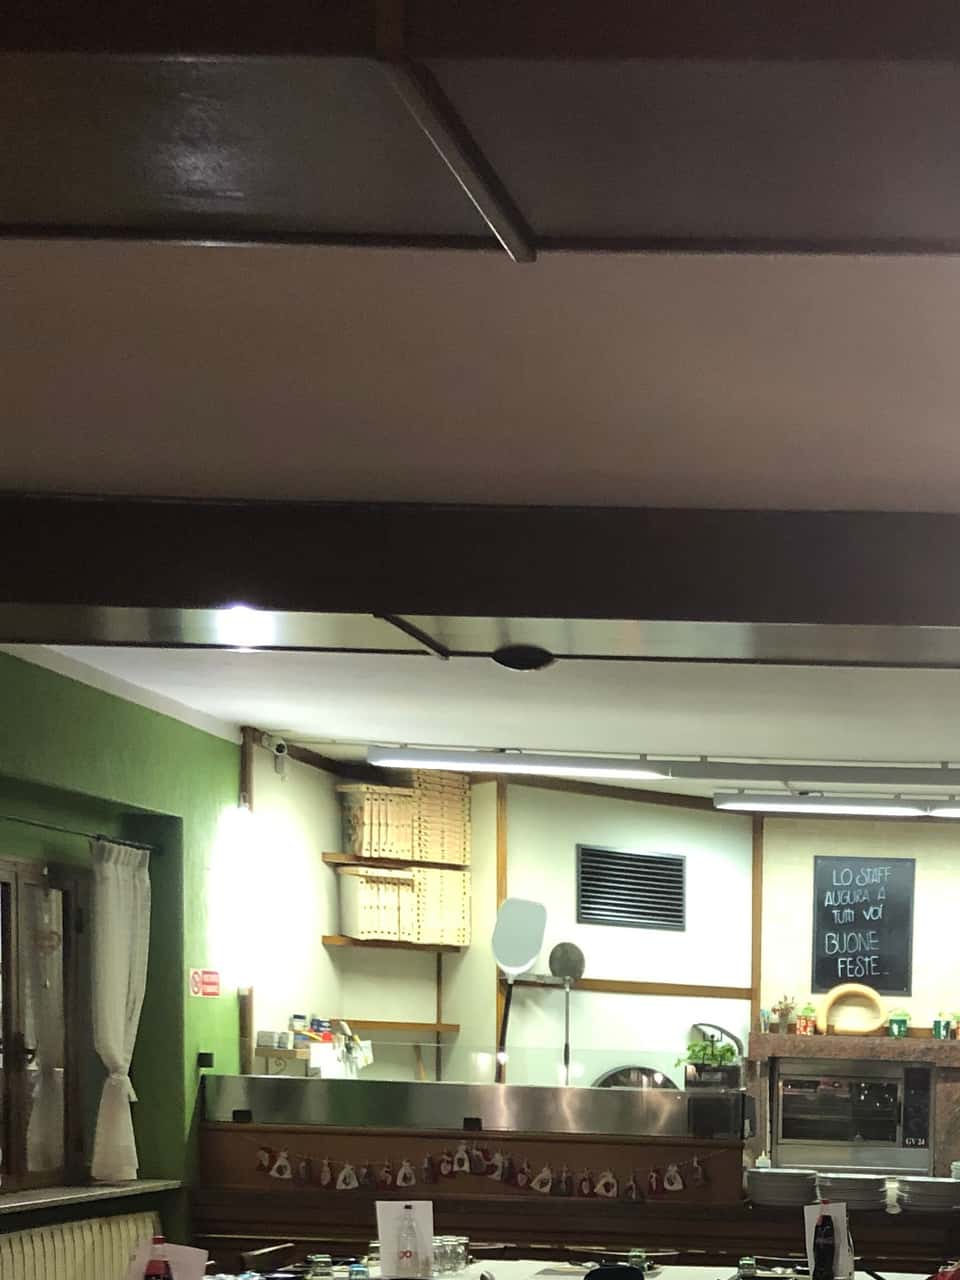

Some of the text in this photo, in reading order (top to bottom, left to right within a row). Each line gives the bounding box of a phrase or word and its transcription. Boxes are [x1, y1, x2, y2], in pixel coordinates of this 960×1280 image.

[832, 866, 892, 886] LO STAFF
[824, 886, 886, 907] AUGURA A
[825, 930, 880, 955] BUONE
